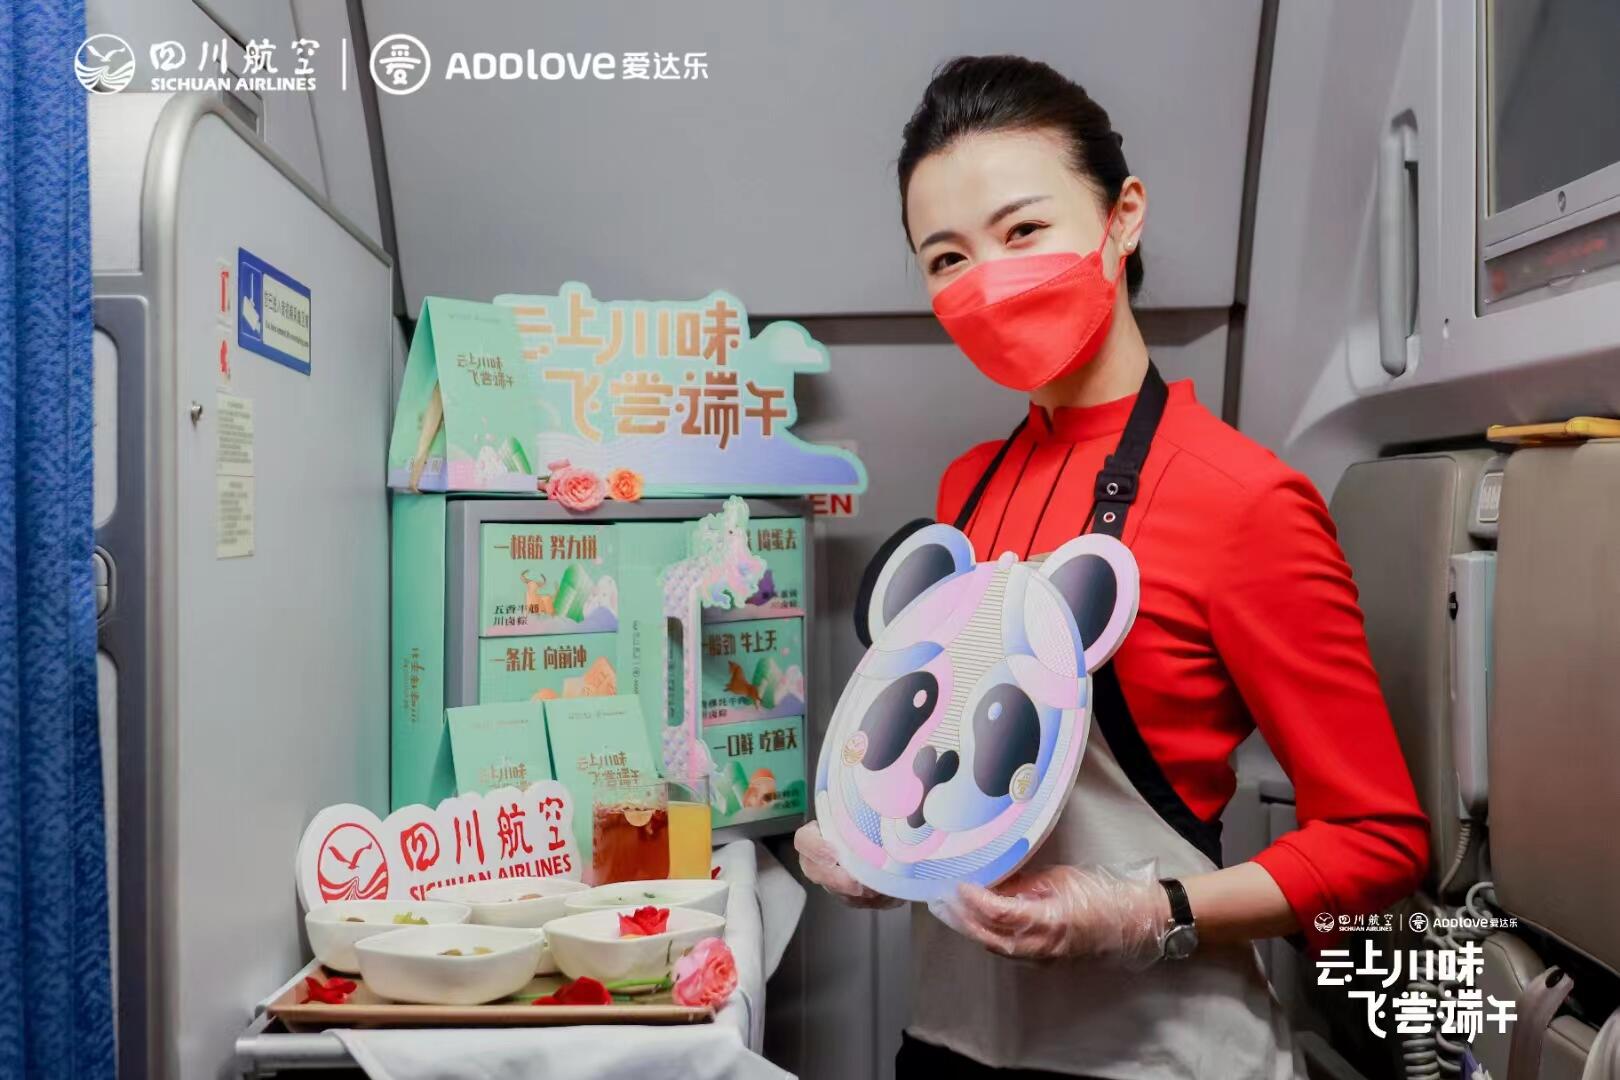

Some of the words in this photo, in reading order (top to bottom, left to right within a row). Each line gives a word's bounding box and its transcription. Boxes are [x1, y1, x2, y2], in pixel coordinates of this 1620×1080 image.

[544, 371, 788, 450] 飞尝端午
[493, 535, 543, 560] 一根筋
[550, 534, 598, 560] 努力拼
[740, 630, 777, 652] 牛上天
[489, 646, 536, 672] 一条龙
[543, 644, 588, 670] 向前冲
[713, 732, 754, 757] 一口鲜
[760, 728, 798, 752] 吃遍天
[400, 797, 566, 872] 四川航空
[498, 853, 572, 880] AIRLINES
